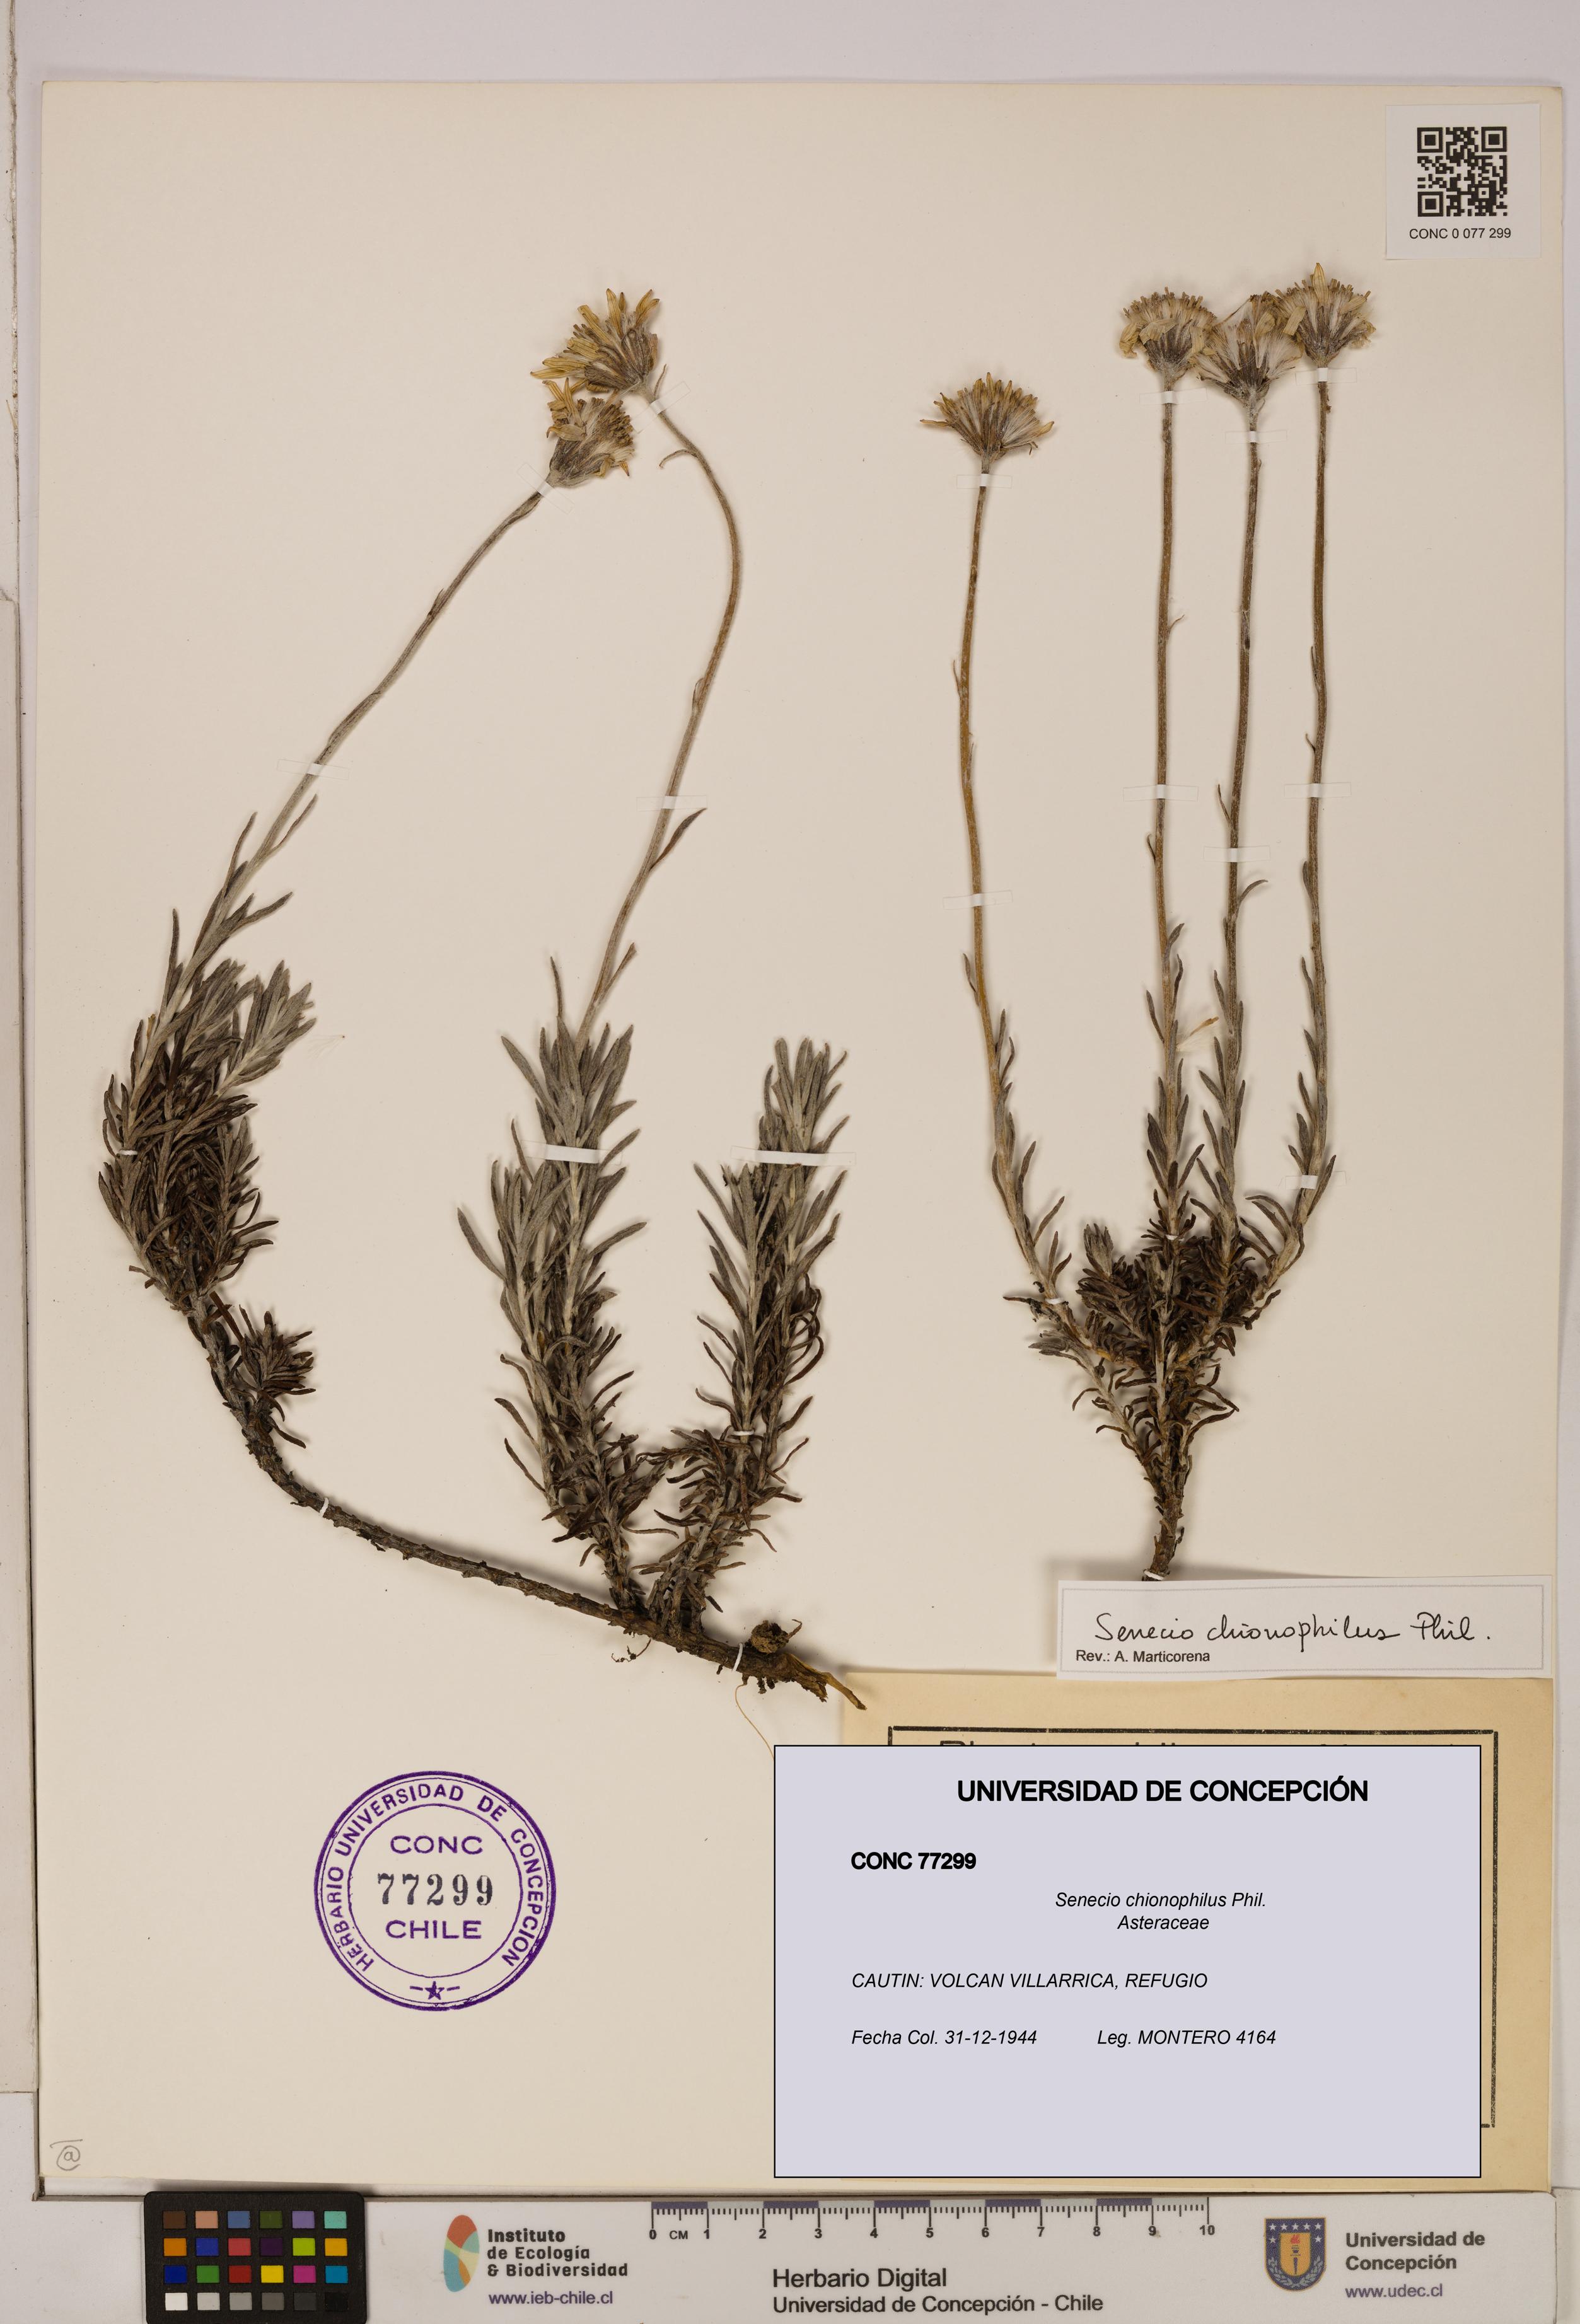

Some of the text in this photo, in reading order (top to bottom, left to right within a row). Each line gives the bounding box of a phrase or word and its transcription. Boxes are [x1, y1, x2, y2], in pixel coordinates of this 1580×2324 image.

[1409, 228, 1511, 239] CONC 0 077 299
[1095, 1612, 1194, 1641] Senecio
[1076, 1650, 1211, 1663] Rev.: A. Marticorena
[390, 1835, 484, 1855] CONC
[327, 1783, 544, 1972] HERBARIO UNIVERSIDAD DE CONCEPCION
[377, 1873, 493, 1906] 77299
[385, 1919, 482, 1940] CHILE
[487, 2228, 566, 2243] Instituto
[649, 2224, 1216, 2240] 0 CM 1 2 3 4 5 6 7 8 9 10
[1346, 2231, 1485, 2248] Universidad de
[487, 2245, 590, 2262] de Ecología
[487, 2262, 628, 2277] & Biodiversidad
[1345, 2254, 1457, 2273] Concepción
[773, 2268, 947, 2292] Herbario Digital
[488, 2290, 613, 2304] www.ieb-chile.cl
[1345, 2283, 1443, 2298] www.udec.cl
[773, 2296, 886, 2313] Universidad
[892, 2296, 916, 2313] de
[922, 2294, 1035, 2316] Concepción
[1054, 2294, 1103, 2311] Chile
